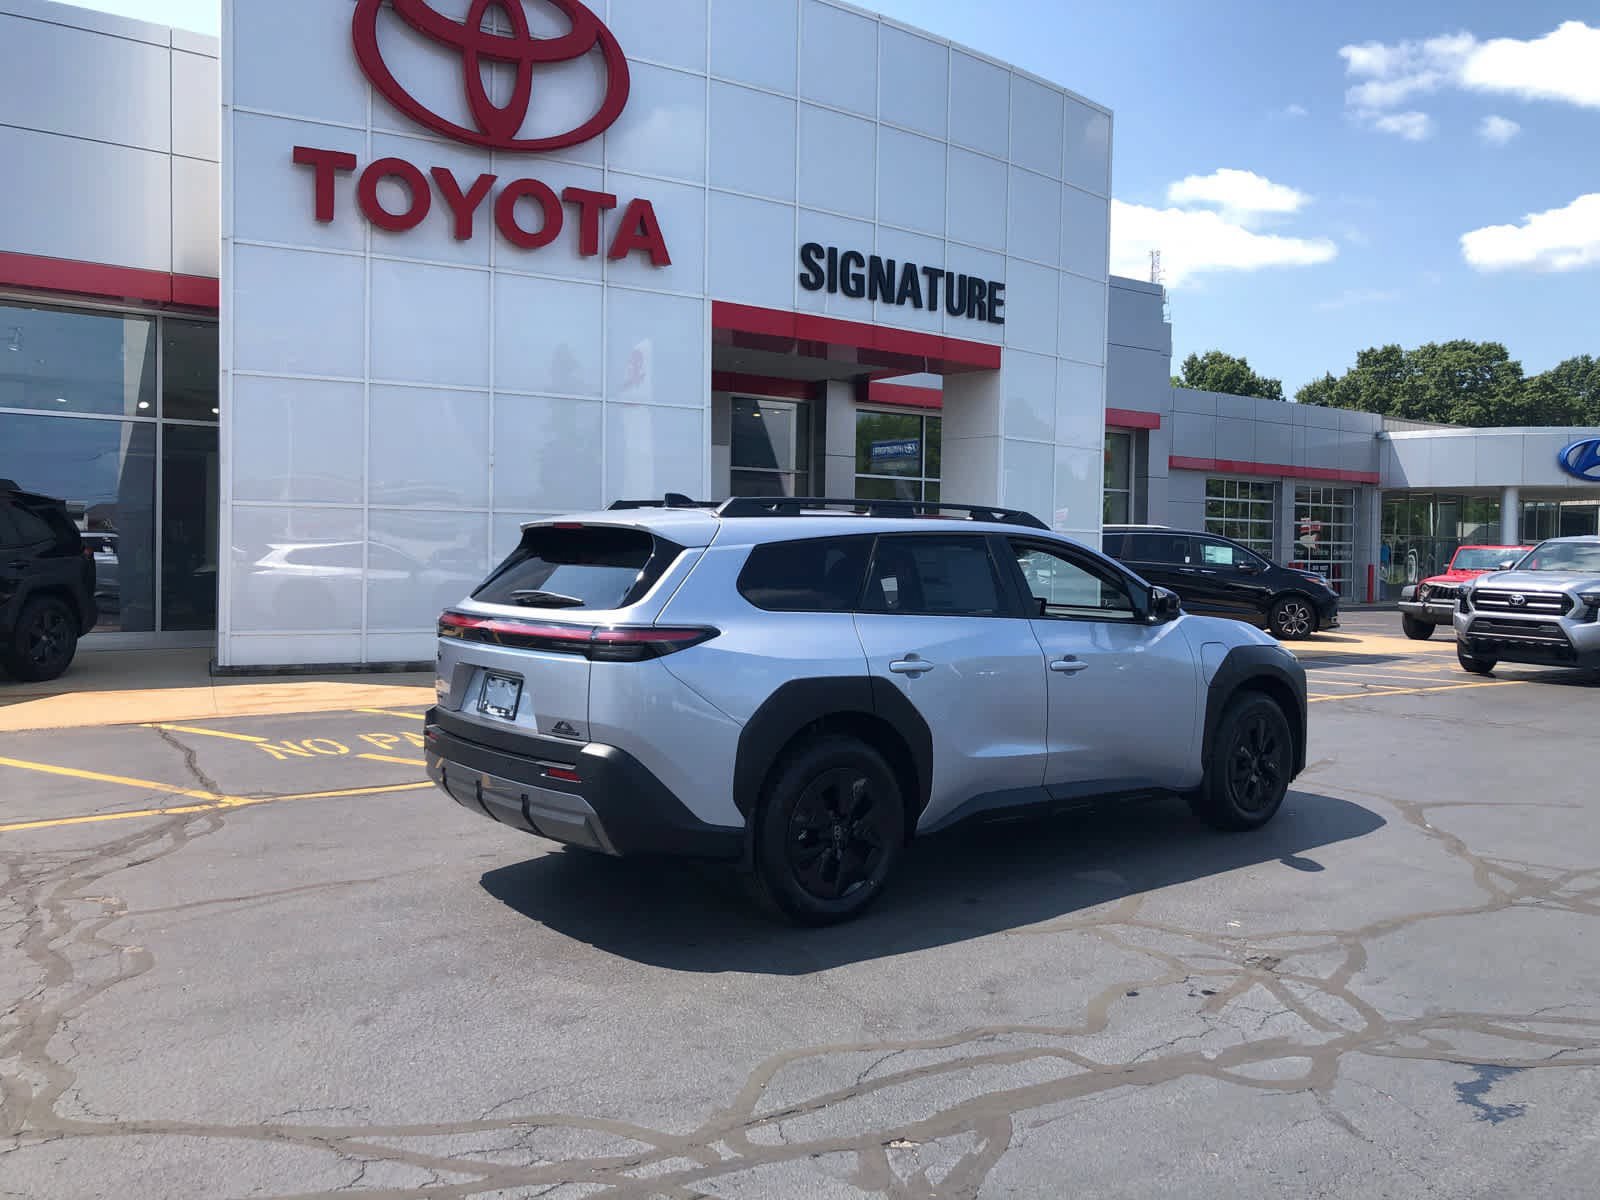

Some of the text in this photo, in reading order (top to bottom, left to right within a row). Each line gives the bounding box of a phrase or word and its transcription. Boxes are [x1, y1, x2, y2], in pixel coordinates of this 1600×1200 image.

[293, 146, 672, 267] TOYOTA
[800, 242, 1006, 325] SIGNATURE
[256, 738, 350, 760] NO
